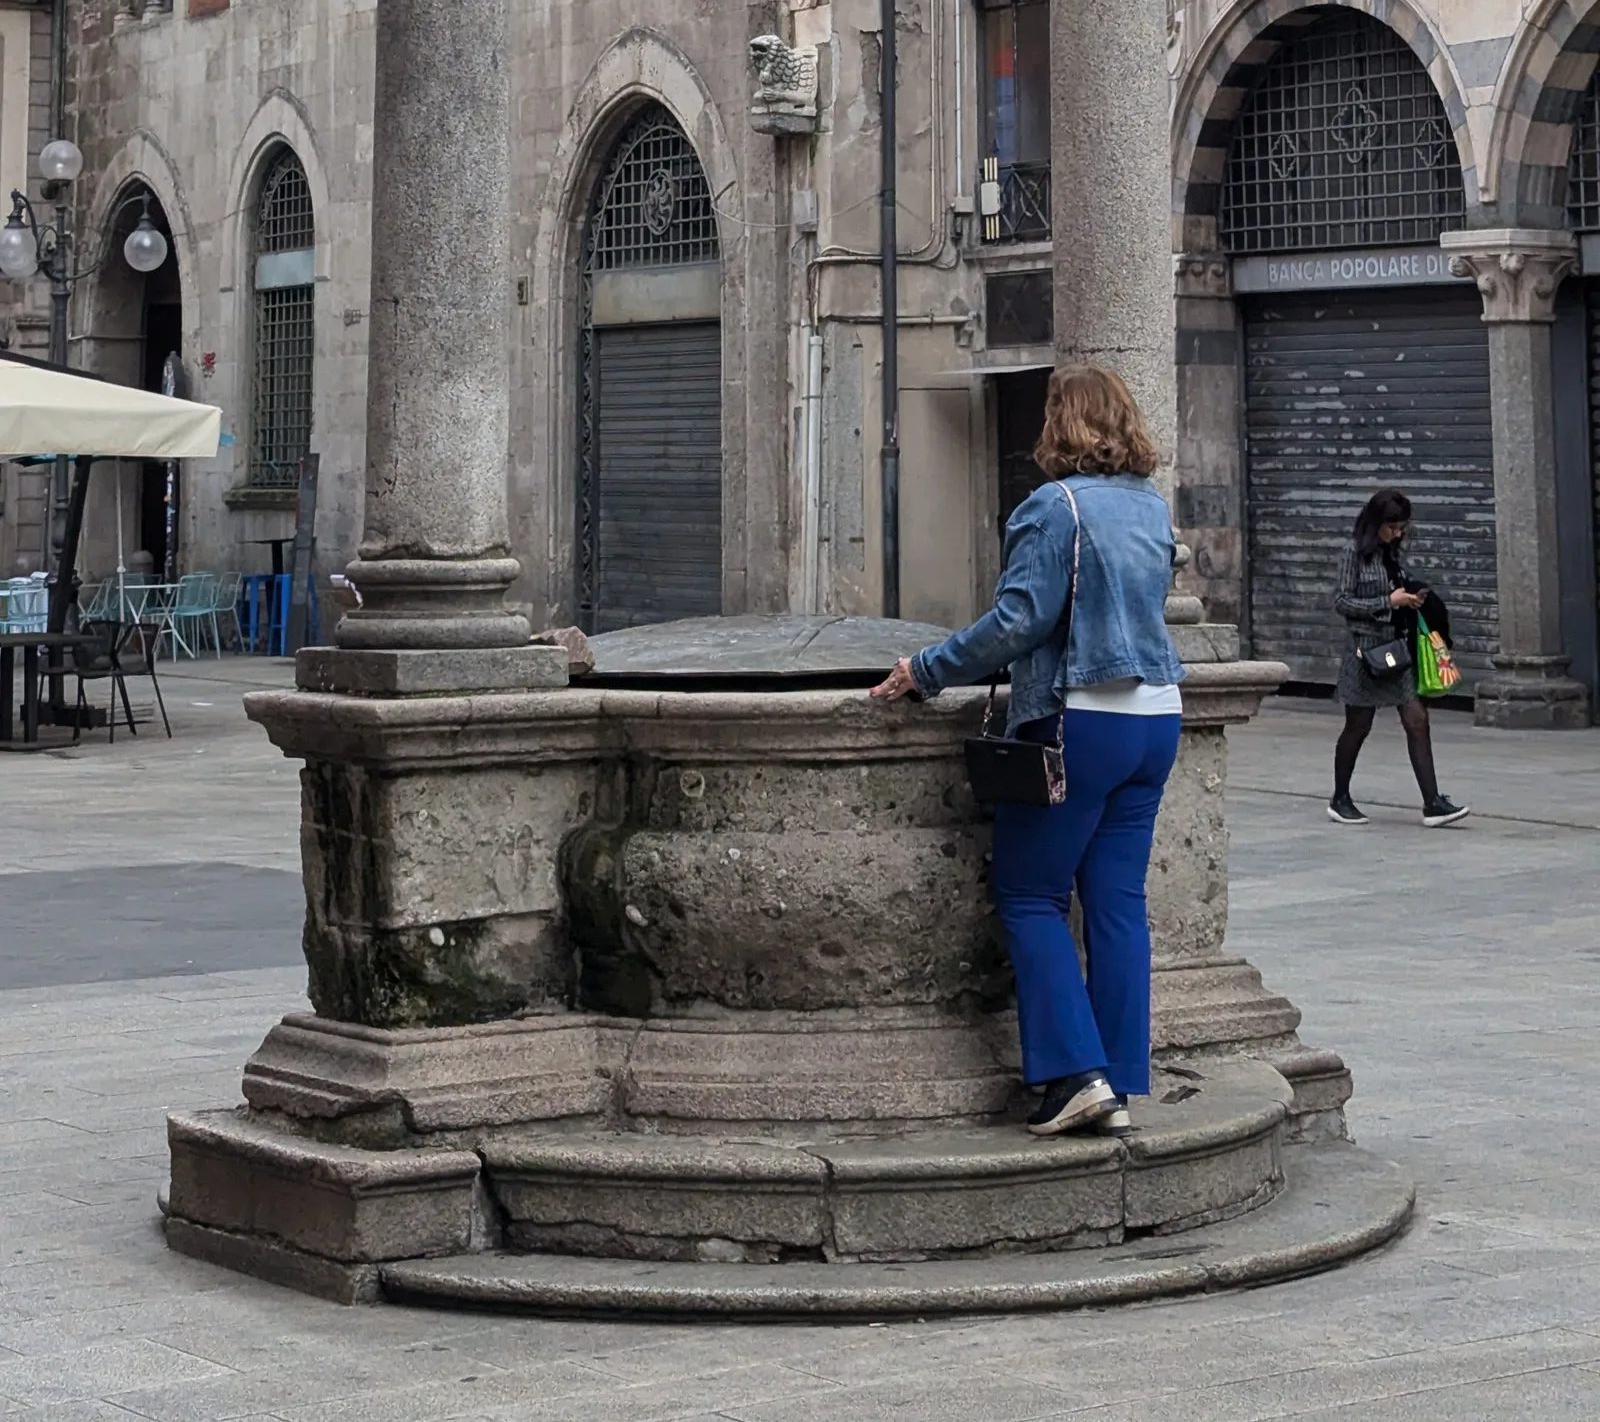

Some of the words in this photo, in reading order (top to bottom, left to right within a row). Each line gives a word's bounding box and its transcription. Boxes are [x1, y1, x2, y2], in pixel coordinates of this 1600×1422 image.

[1269, 261, 1324, 282] BANCA
[1330, 255, 1420, 279] POPOLARE
[1426, 254, 1443, 275] DI
